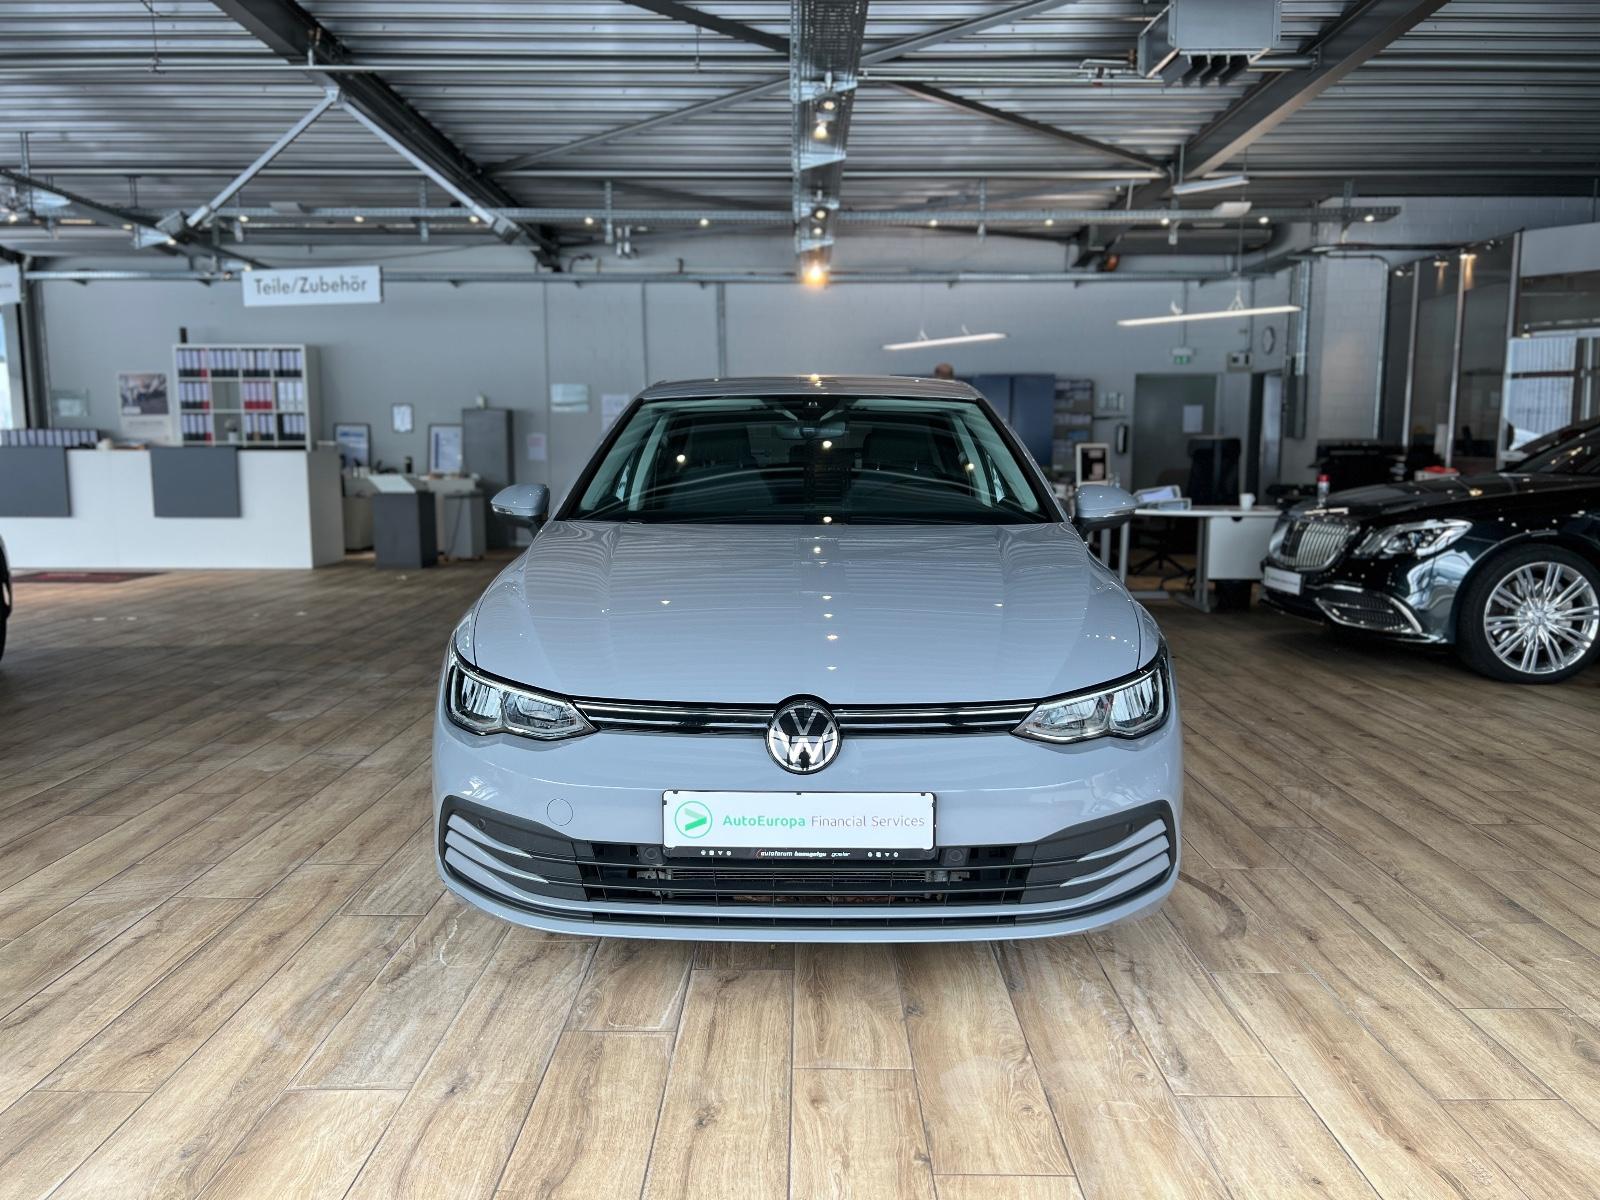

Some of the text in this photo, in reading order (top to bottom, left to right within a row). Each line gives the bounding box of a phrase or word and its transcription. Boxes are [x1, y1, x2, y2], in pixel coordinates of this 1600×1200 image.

[253, 275, 367, 296] Teile/Zubehör
[770, 706, 838, 768] VW
[722, 814, 926, 829] AutoEuropa Financial Services
